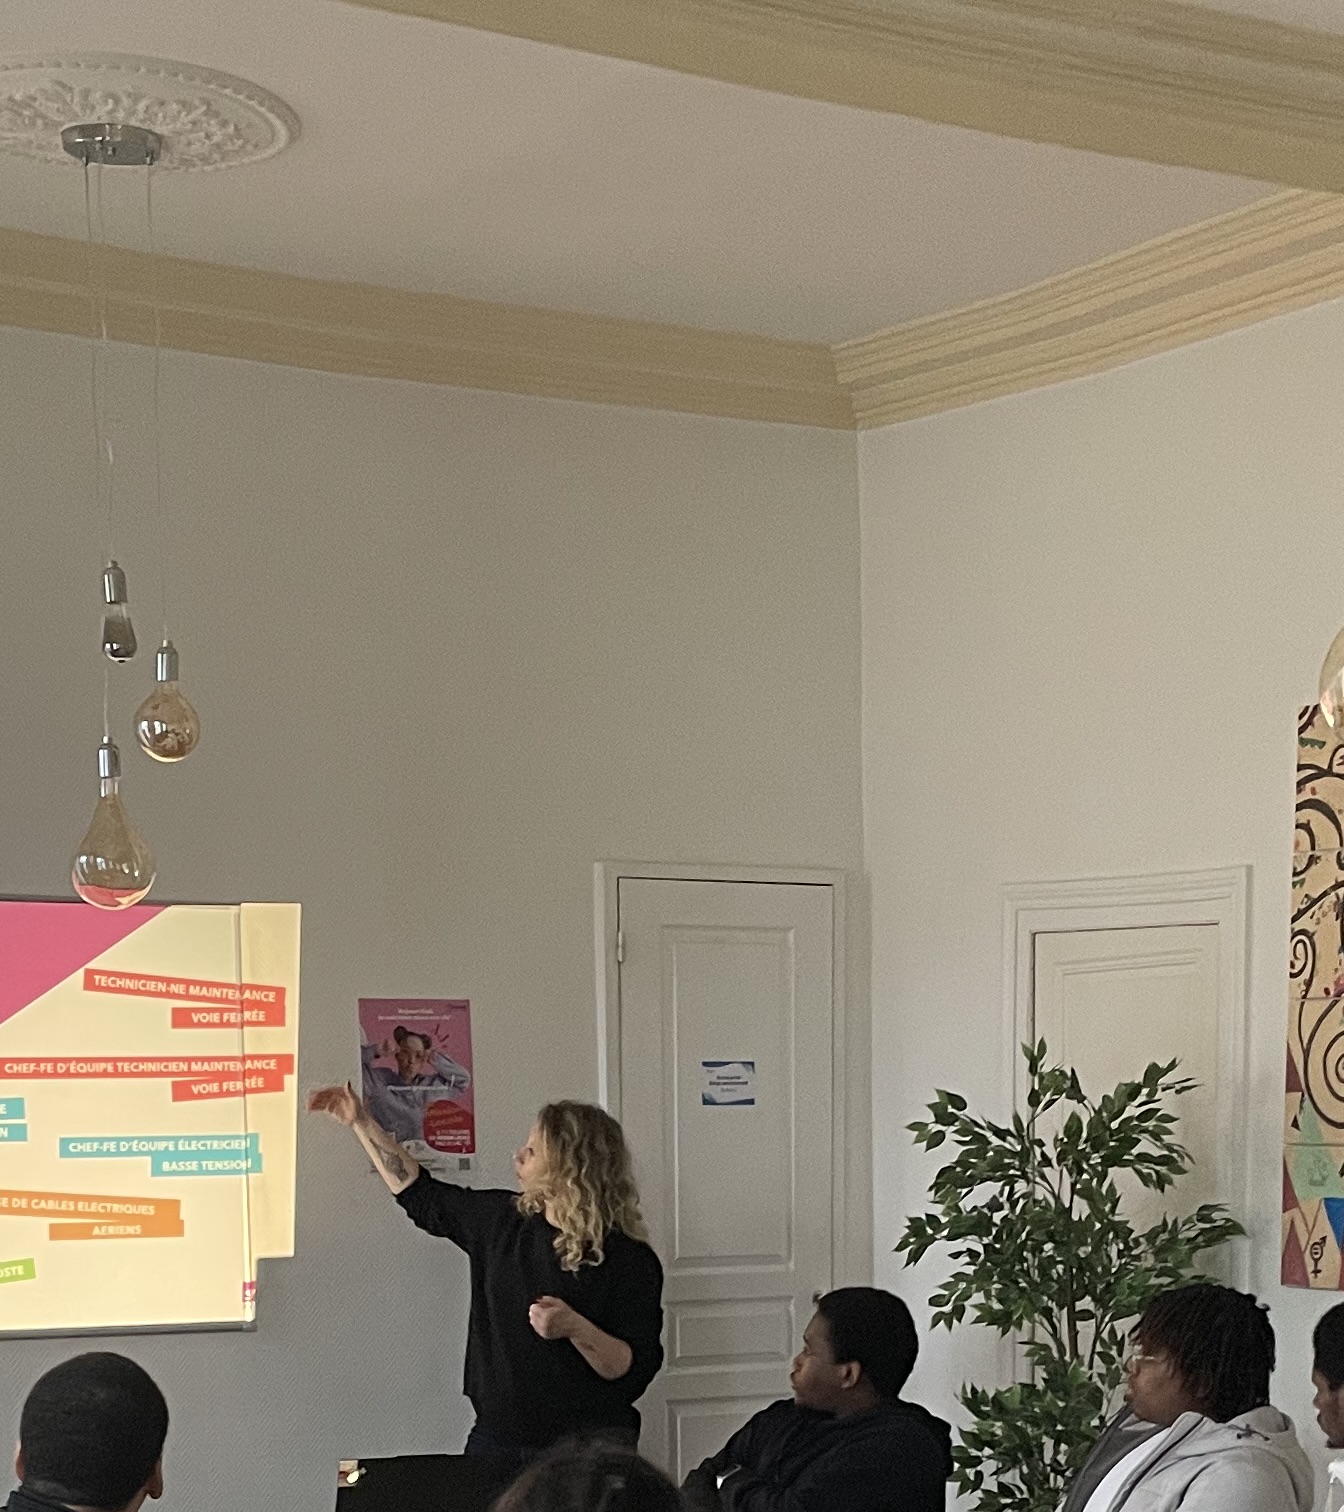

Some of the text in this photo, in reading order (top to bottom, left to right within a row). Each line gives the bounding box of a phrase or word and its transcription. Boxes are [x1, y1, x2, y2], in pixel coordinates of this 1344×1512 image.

[93, 975, 186, 994] TECHNICIEN-NE
[192, 1012, 220, 1023] VOIE
[4, 1062, 54, 1074] CHEF-FE
[116, 1061, 188, 1072] TECHNICIEN
[191, 1083, 220, 1095] VOIE
[68, 1141, 117, 1153] CHEF-FE
[162, 1158, 252, 1172] BASSE TENSION
[12, 1198, 29, 1208] DE
